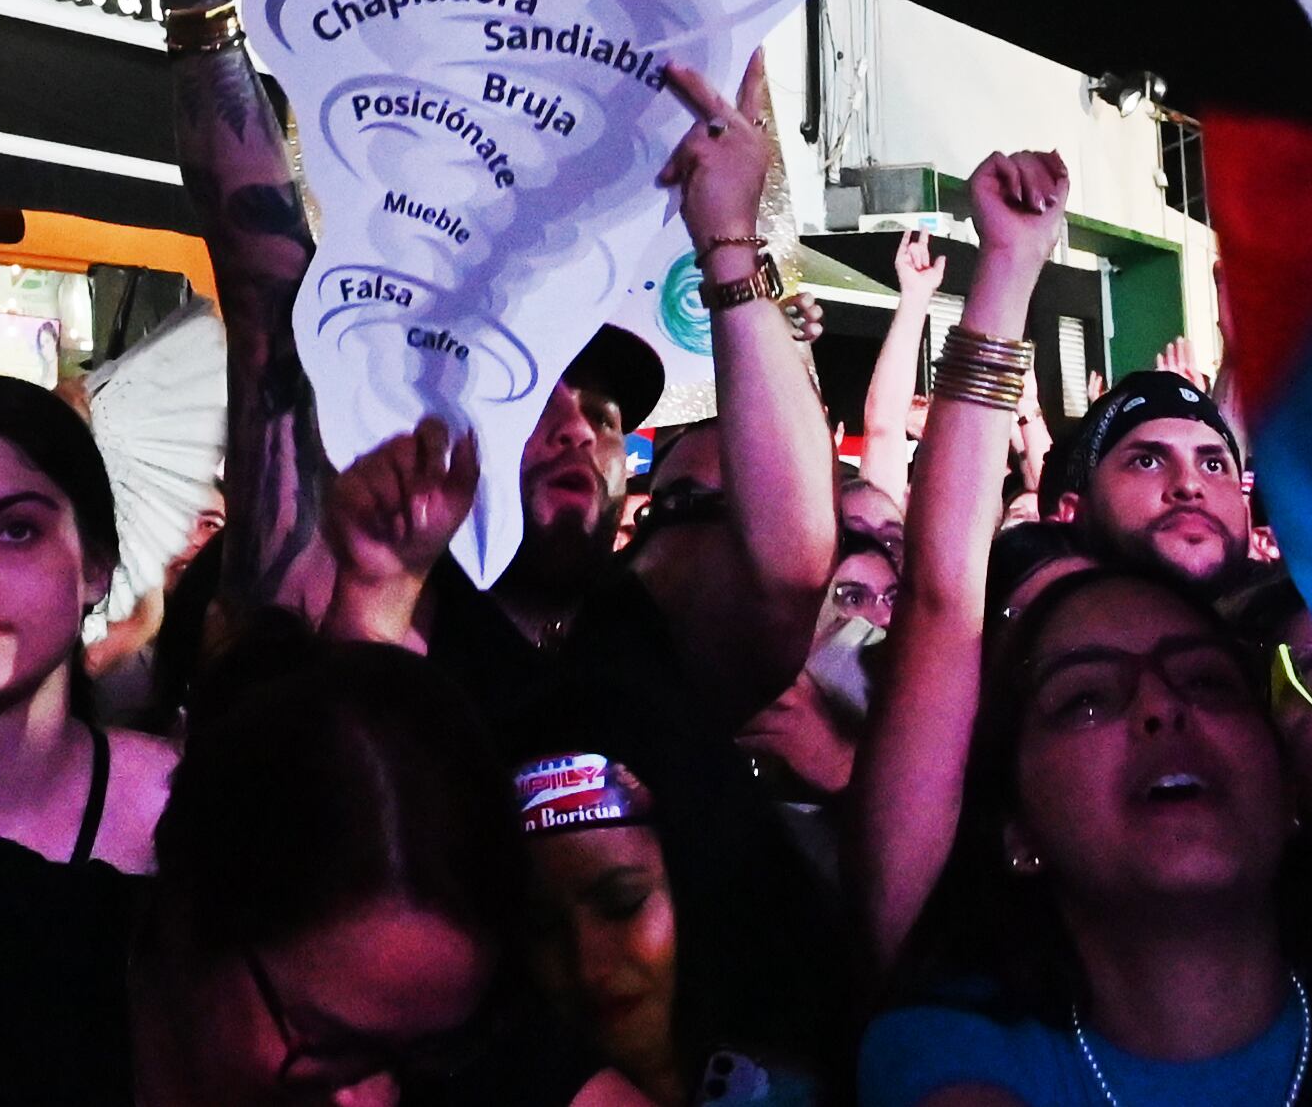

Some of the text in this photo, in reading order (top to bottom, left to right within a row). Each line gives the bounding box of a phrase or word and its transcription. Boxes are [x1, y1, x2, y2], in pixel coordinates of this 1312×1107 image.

[484, 20, 667, 93] Sandiabla
[482, 72, 576, 137] Bruja
[351, 89, 516, 189] Posiciónate
[382, 190, 471, 245] Mueble
[339, 274, 413, 308] Falsa
[406, 325, 471, 362] Cafre
